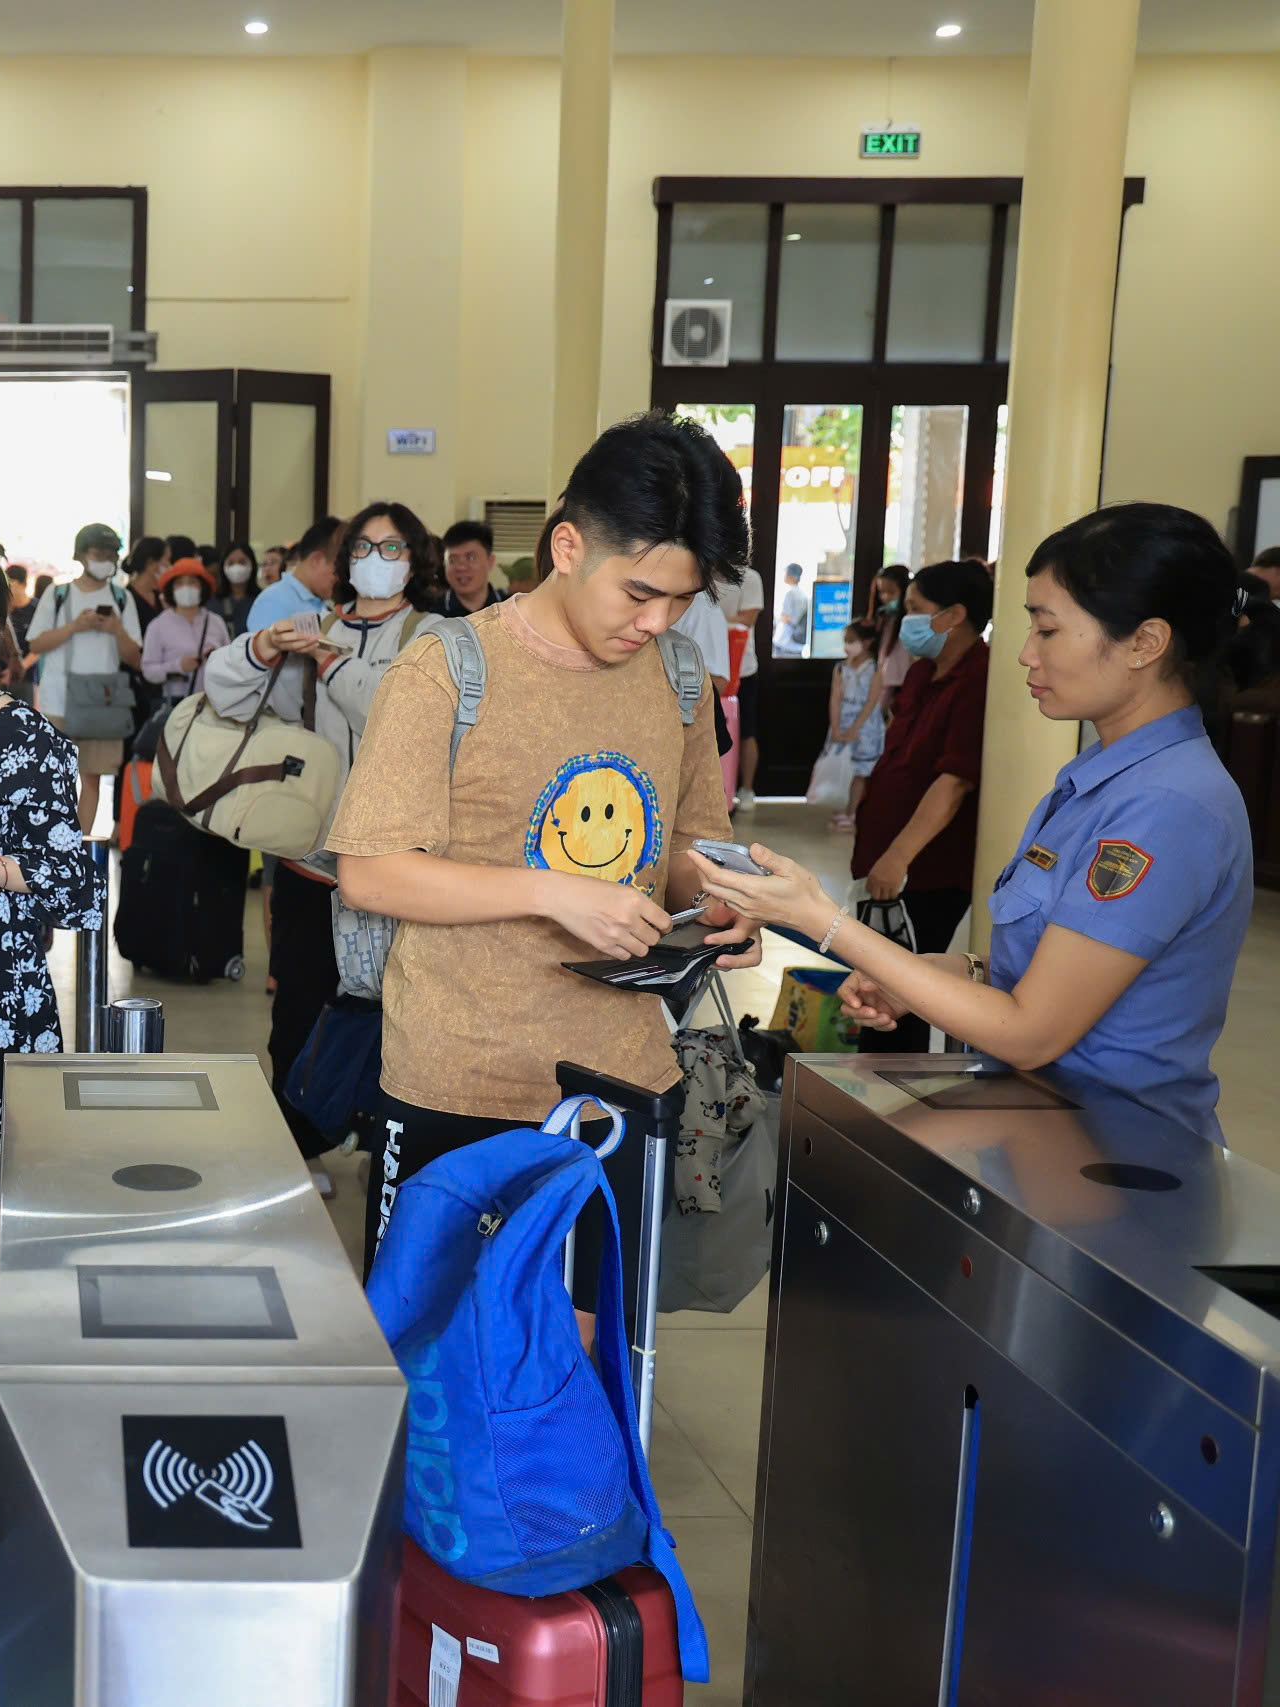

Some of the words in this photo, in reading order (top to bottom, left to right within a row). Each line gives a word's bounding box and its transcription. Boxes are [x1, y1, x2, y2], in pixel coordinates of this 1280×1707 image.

[866, 134, 918, 153] EXIT
[373, 1119, 404, 1262] HAD
[406, 1328, 468, 1562] adida
